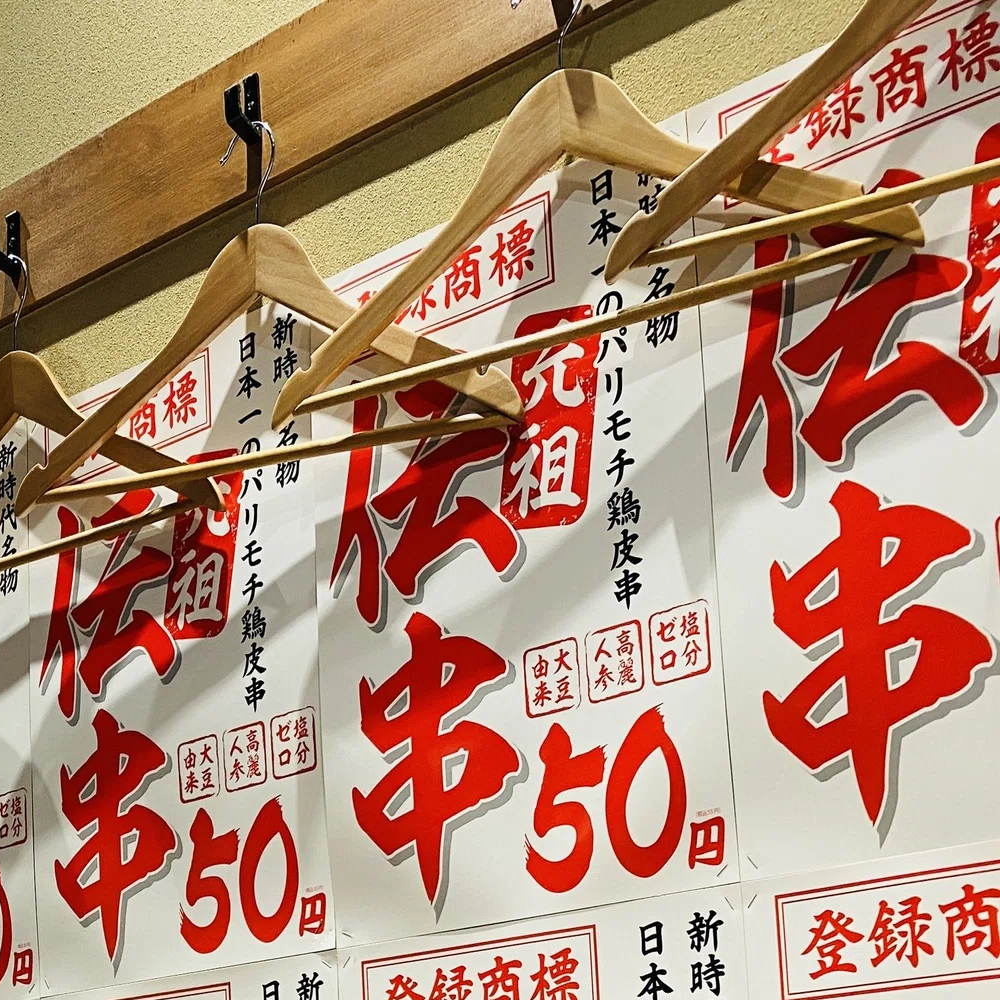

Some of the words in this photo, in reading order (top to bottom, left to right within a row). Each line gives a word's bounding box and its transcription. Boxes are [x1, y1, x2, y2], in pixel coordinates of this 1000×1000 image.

[760, 11, 1000, 165] 録商標
[357, 217, 537, 331] 商標
[271, 312, 301, 488] 新時名物
[506, 319, 584, 517] 元祖
